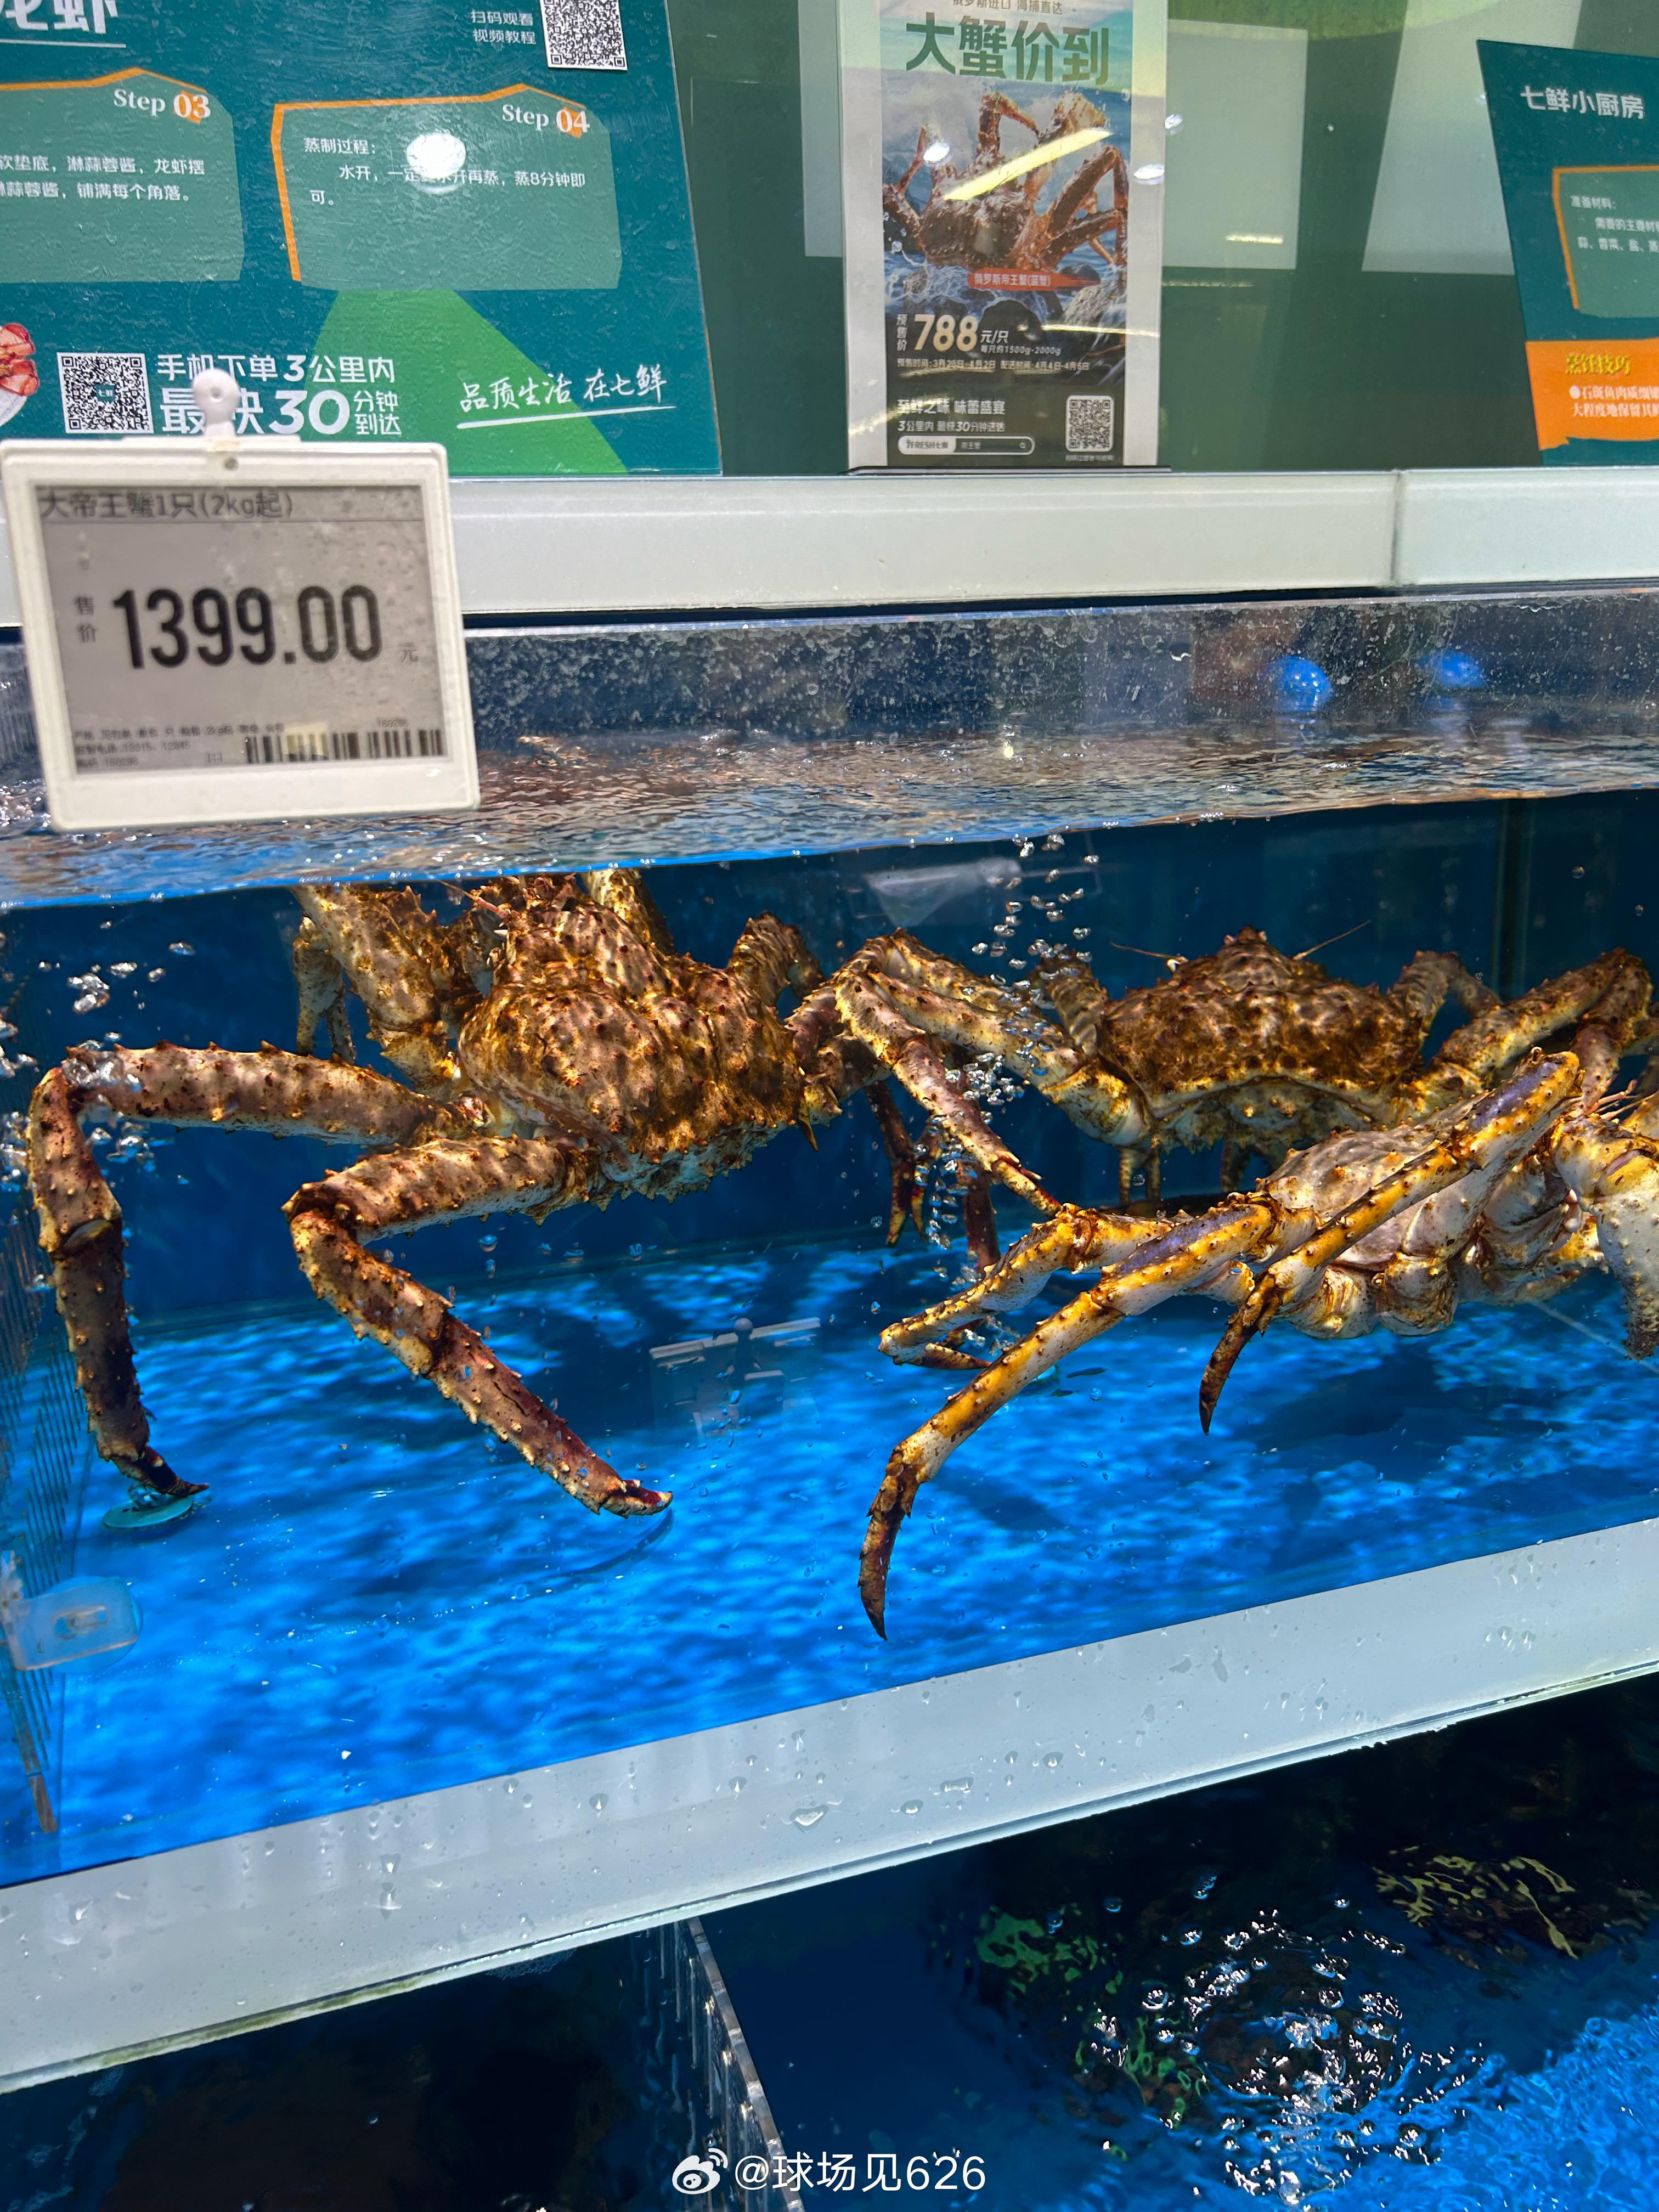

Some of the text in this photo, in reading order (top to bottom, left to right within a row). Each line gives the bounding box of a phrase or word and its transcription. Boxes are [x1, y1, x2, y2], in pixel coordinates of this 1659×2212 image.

[471, 10, 533, 26] 扫码观看
[473, 29, 536, 44] 视频教程
[906, 12, 1109, 85] 大蟹价到
[114, 88, 211, 119] Step 03
[1520, 85, 1644, 120] 七鲜小厨房
[502, 104, 590, 134] Step 04
[896, 314, 908, 352] 预售价
[914, 314, 1009, 352] 788 元/只
[354, 390, 399, 413] 分钟
[460, 363, 667, 413] 品质生活 在七鲜
[954, 399, 1006, 415] 味蕾盛宴
[354, 413, 402, 435] 到达
[898, 420, 934, 432] 3公里内
[37, 491, 293, 518] 大帝王蟹1只(2kg起)
[75, 595, 99, 643] 售价
[113, 585, 383, 670] 1399.00
[398, 642, 419, 663] 元
